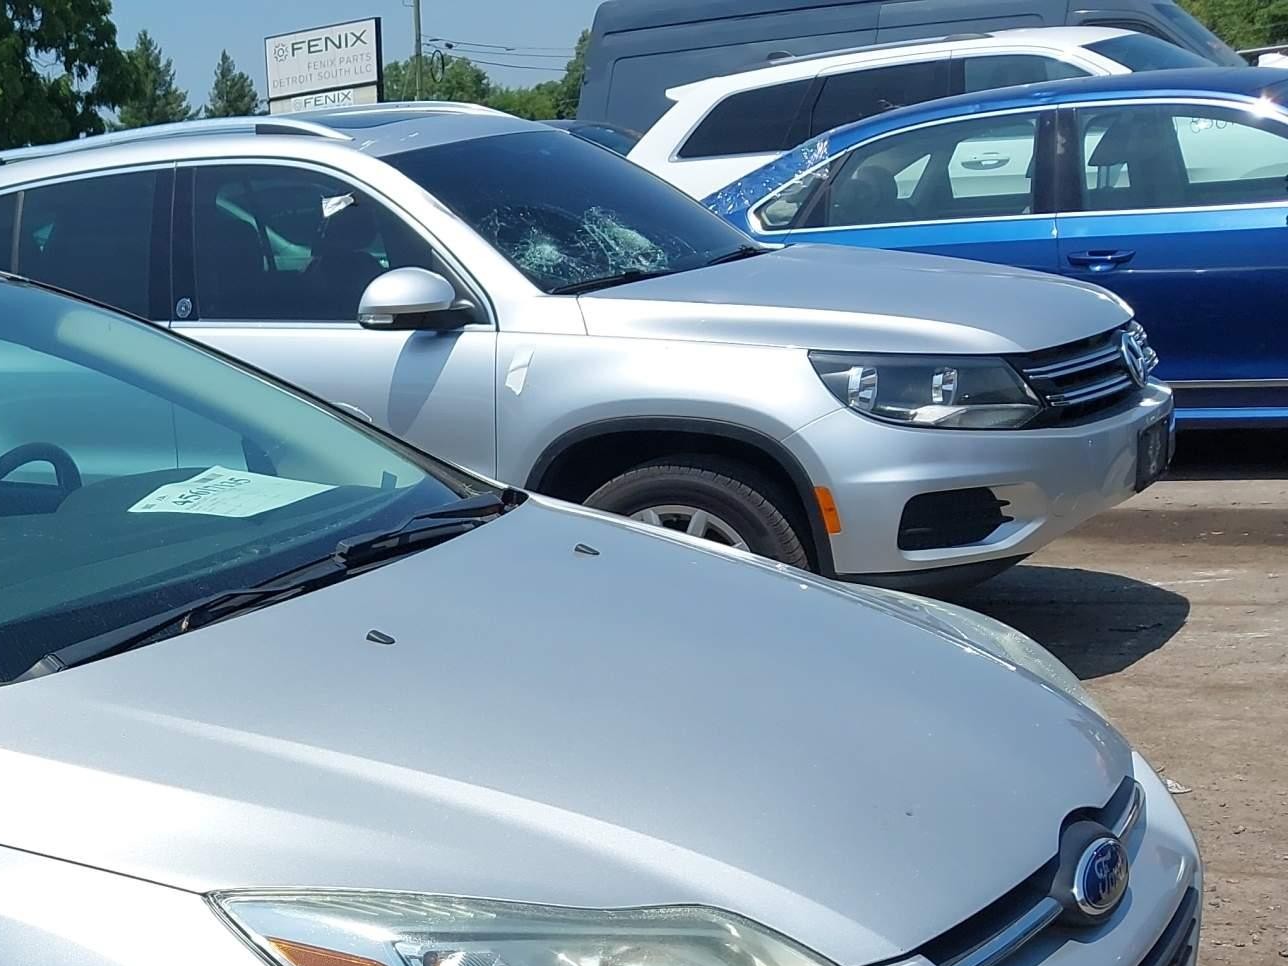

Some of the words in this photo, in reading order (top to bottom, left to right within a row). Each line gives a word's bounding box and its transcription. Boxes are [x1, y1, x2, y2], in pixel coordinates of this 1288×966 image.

[291, 29, 369, 57] FENIX
[308, 58, 336, 72] FENIX
[340, 52, 373, 66] PARTS
[272, 73, 314, 89] DETROIT
[318, 68, 352, 82] SOUTH
[355, 64, 373, 76] LLC
[304, 91, 353, 109] FENIX
[1095, 846, 1125, 897] Ford
